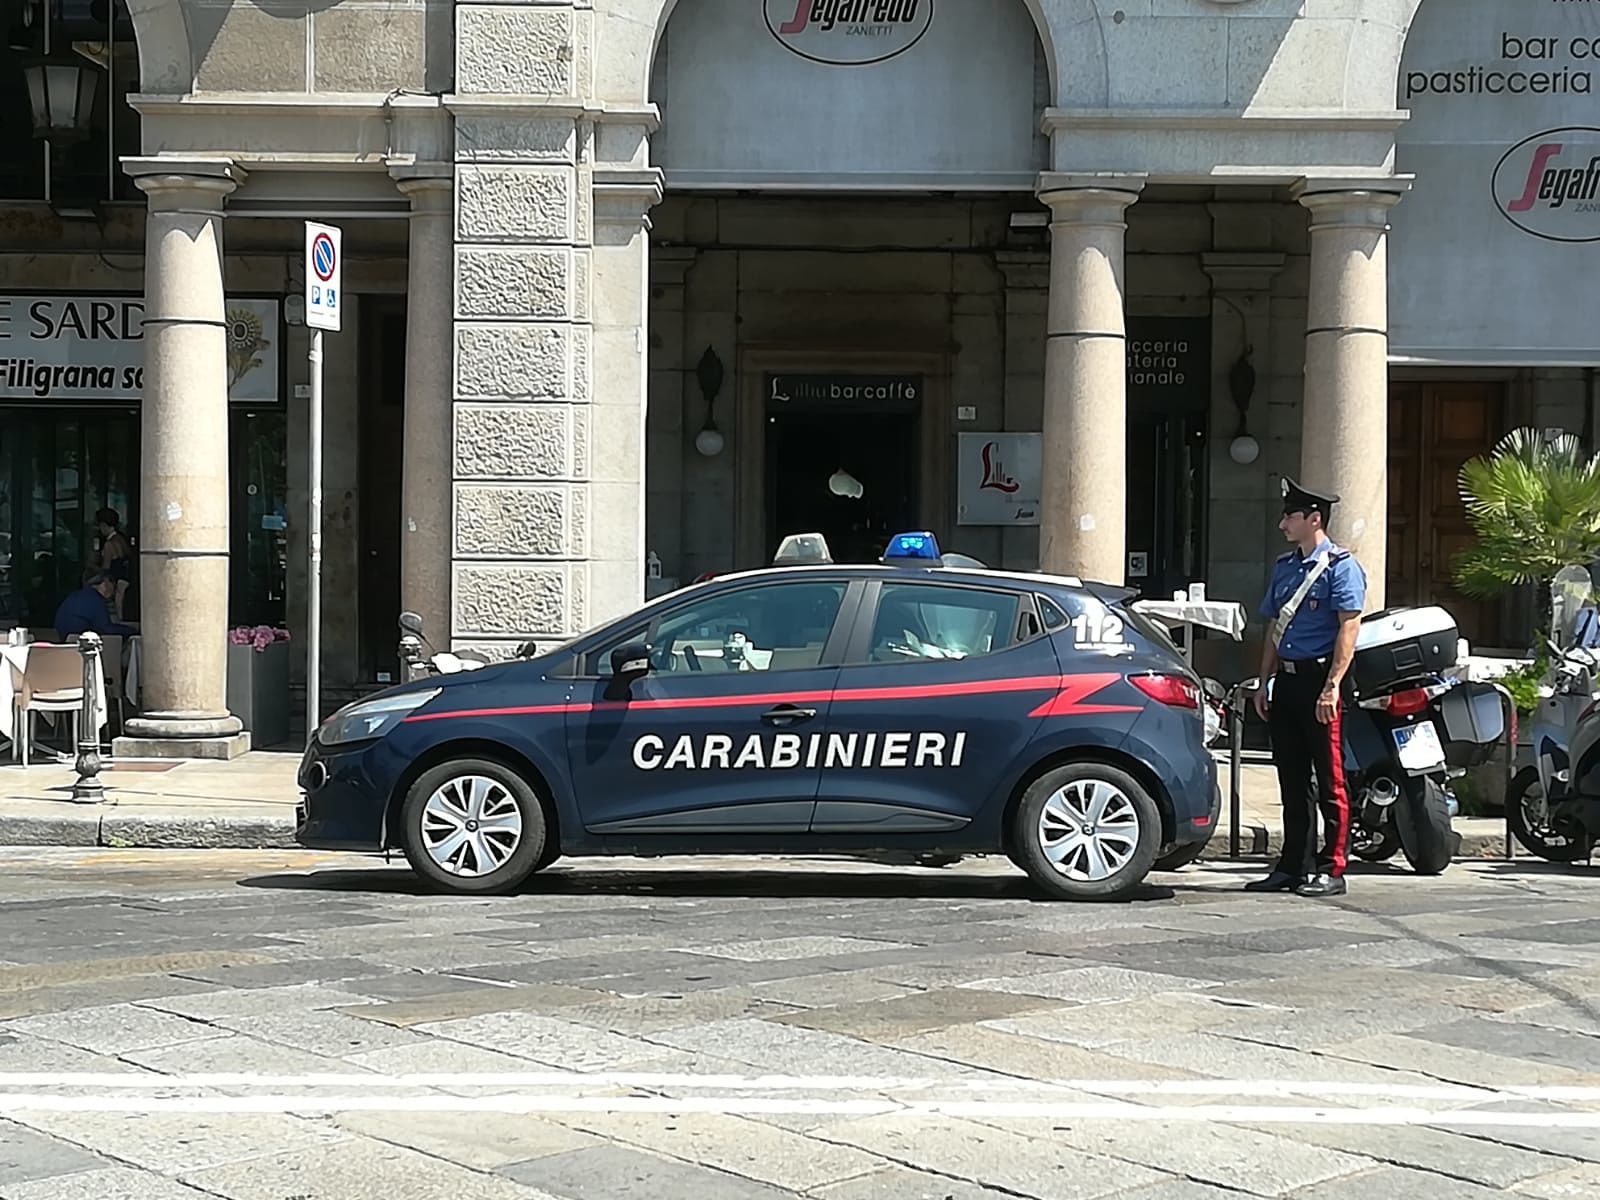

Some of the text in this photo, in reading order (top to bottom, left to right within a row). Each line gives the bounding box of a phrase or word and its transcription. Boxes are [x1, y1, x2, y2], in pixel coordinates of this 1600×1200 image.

[846, 25, 893, 36] ZANETTI
[1502, 32, 1559, 59] bar
[1406, 65, 1591, 99] pasticceria
[30, 301, 145, 339] SARD
[0, 358, 115, 396] Filigrana
[1071, 614, 1123, 643] 112
[632, 732, 967, 769] CARABINIERI
